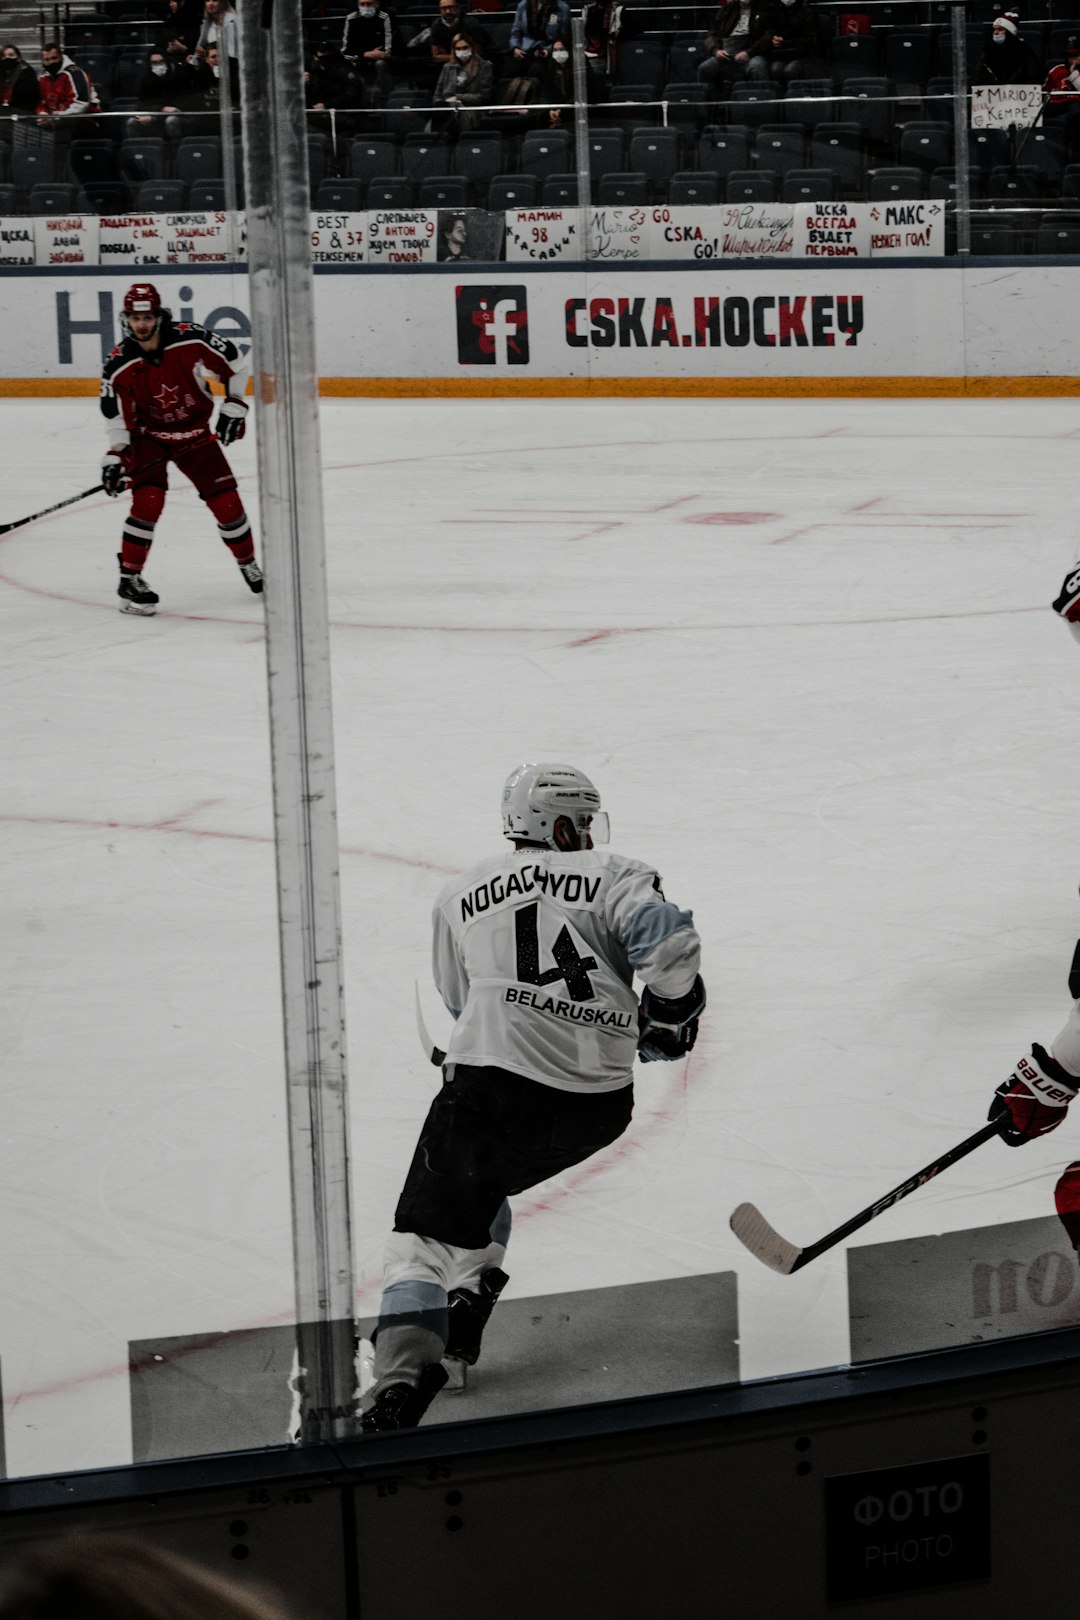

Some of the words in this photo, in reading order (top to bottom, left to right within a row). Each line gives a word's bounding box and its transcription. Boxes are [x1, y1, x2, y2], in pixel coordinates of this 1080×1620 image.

[988, 88, 1027, 103] MARIO
[988, 107, 1028, 121] KEMPE
[517, 211, 562, 223] МАМИН
[629, 209, 646, 225] 23
[815, 204, 848, 216] ЦСКА
[317, 216, 349, 228] BEST
[369, 223, 378, 236] 9
[385, 226, 416, 236] АНТОН
[426, 222, 434, 237] 9
[806, 217, 857, 229] ВСЕГДА
[330, 232, 342, 248] &
[347, 232, 362, 245] 37
[532, 227, 548, 243] 98
[809, 230, 853, 243] БУДЕТ
[871, 234, 901, 249] НУЖЕН
[905, 227, 932, 247] ГОЛ!
[168, 241, 195, 252] ЦСКА
[592, 235, 640, 259] Kempe
[694, 238, 718, 259] GO!
[805, 245, 859, 256] ПЕРВЫМ
[564, 296, 864, 347] CSKA.HOCKEY
[461, 865, 601, 922] NOGACHYOV
[514, 902, 598, 1002] 14
[505, 988, 631, 1028] BELARUSKALI
[1016, 1058, 1075, 1104] BAUER
[853, 1482, 963, 1526] ФОТО
[866, 1535, 953, 1568] PHOTO
